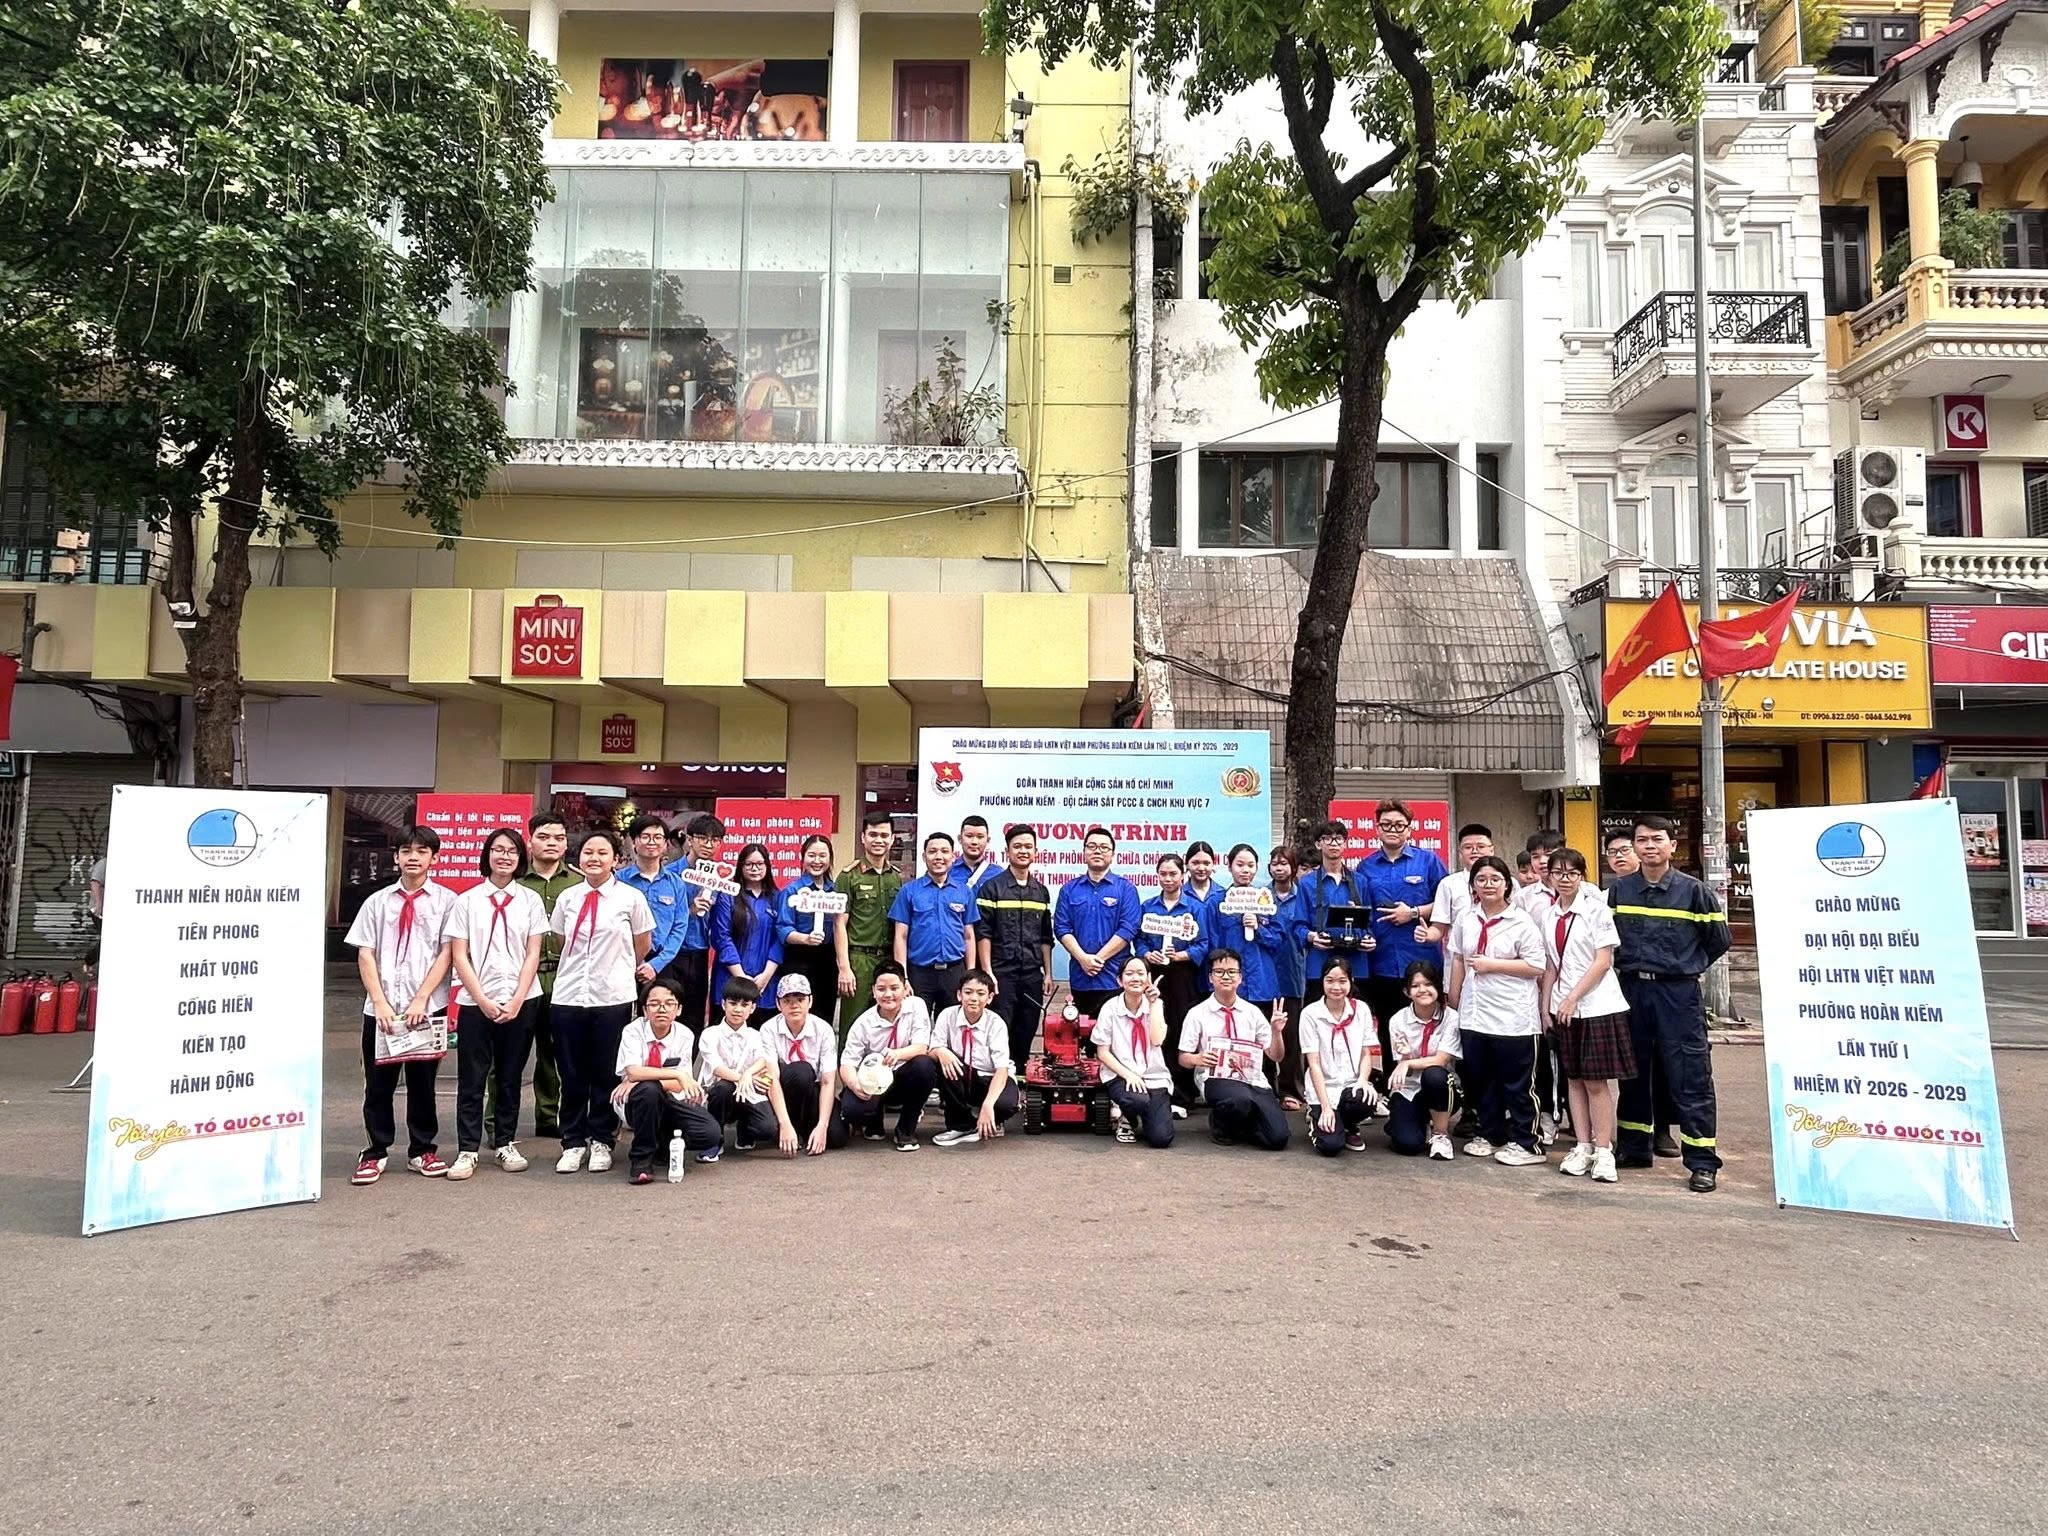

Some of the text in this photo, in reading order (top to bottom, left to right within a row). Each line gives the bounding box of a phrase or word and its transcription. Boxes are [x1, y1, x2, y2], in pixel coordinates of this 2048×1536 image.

[1957, 412, 1981, 436] K
[519, 617, 576, 639] MINI
[1645, 658, 1908, 680] HE HOUSE
[1813, 712, 1859, 721] 0906.822.050
[605, 724, 632, 735] MINI
[1060, 739, 1071, 750] VIỆT
[1073, 741, 1086, 749] NAM
[1016, 776, 1036, 788] ĐOÀN
[1039, 778, 1063, 788] THANH
[1066, 776, 1083, 789] NIÊN
[1085, 777, 1106, 791] CỘNG
[1108, 777, 1123, 789] SẢN
[1138, 777, 1150, 789] CHÍ
[1153, 779, 1173, 789] MINH
[979, 793, 1011, 806] PHƯỜNG
[1013, 794, 1034, 806] HOÀN
[1035, 795, 1055, 807] KIẾM
[1063, 795, 1076, 809] ĐỘI
[1077, 794, 1098, 807] CẢNH
[1101, 796, 1115, 807] SÁT
[1117, 797, 1137, 808] PCCC
[1139, 798, 1145, 808] &
[1147, 798, 1167, 808] CNCH
[1170, 798, 1185, 808] KHU
[1187, 798, 1203, 810] VỰC
[1205, 798, 1210, 808] 7
[426, 811, 450, 821] Chuẩn
[724, 817, 736, 827] An
[741, 817, 761, 827] toàn
[767, 817, 794, 829] phòng
[1357, 818, 1373, 832] hiện
[1424, 818, 1441, 831] cháy
[723, 832, 744, 844] chữa
[746, 832, 766, 845] cháy
[768, 832, 777, 844] là
[779, 832, 799, 847] hạnh
[1111, 821, 1187, 841] TRÌNH
[440, 840, 454, 850] hữa
[456, 840, 475, 850] cháy
[1117, 849, 1140, 865] CHỮA
[699, 862, 714, 874] Tôi
[135, 885, 300, 904] THANH NIÊN HOÀN KIẾM
[1816, 896, 1900, 912] CHÀO MỪNG
[178, 922, 259, 941] TIÊN PHONG
[1805, 929, 1920, 950] ĐẠI HỘI ĐẠI BIỂU
[180, 959, 258, 979] KHÁT VỌNG
[1799, 965, 1935, 987] HỘI LHTN VIỆT NAM
[178, 993, 253, 1016] CỐNG HIẾN
[1799, 1001, 1943, 1023] PHƯỜNG HOÀN KIẾM
[182, 1034, 246, 1054] KIẾN TẠO
[1838, 1038, 1909, 1060] LẦN THỨ I
[170, 1070, 254, 1095] HÀNH ĐỘNG
[1794, 1073, 1839, 1095] NHIỆM
[1844, 1075, 1861, 1094] KỲ
[1867, 1080, 1908, 1098] 2026
[1924, 1084, 1966, 1101] 2029
[134, 1120, 190, 1161] yêu
[277, 1109, 304, 1125] TÔI
[1812, 1116, 1861, 1148] yêu
[1893, 1123, 1945, 1141] QUỐC
[1950, 1128, 1982, 1144] TÔI
